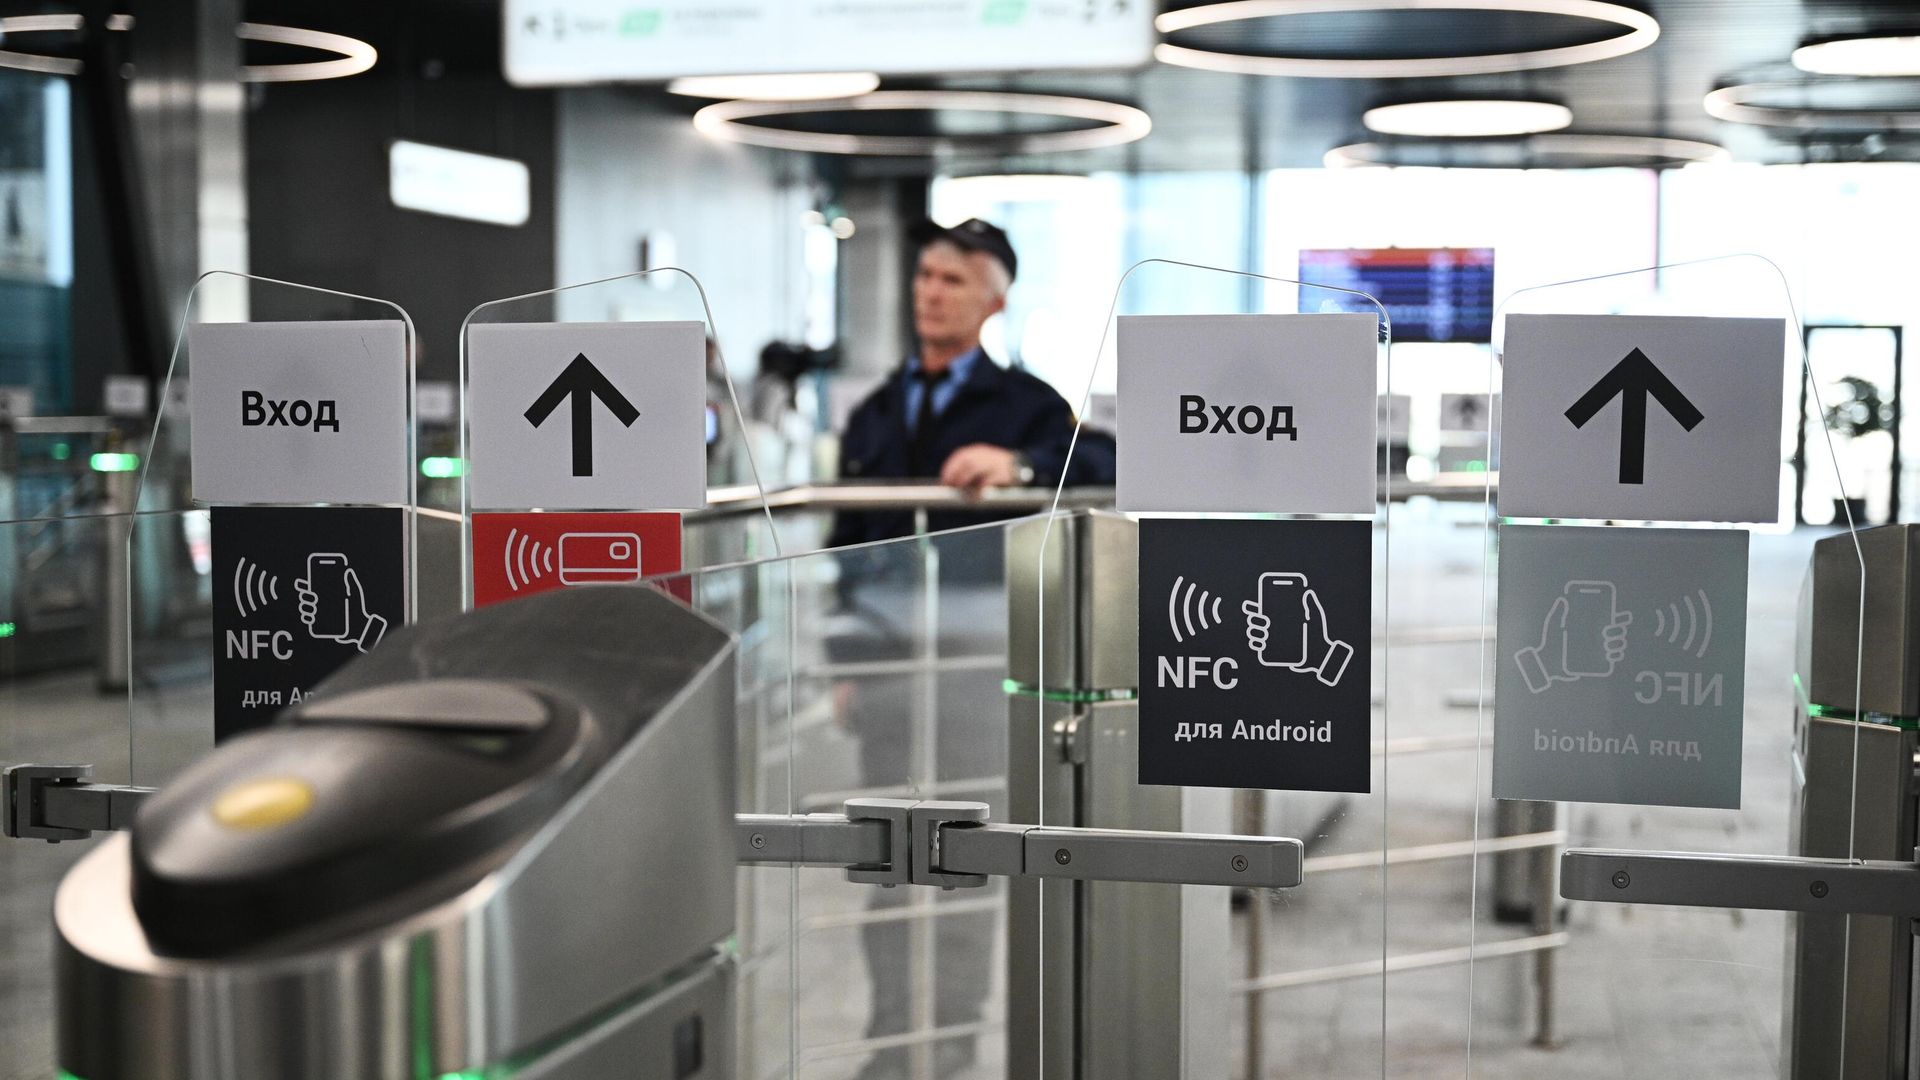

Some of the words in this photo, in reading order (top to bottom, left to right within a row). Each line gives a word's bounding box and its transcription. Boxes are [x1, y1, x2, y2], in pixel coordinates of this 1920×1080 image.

[242, 390, 339, 432] Вход
[1180, 395, 1297, 441] Вход
[227, 629, 294, 660] NFC
[1158, 656, 1239, 690] NFC
[241, 690, 282, 708] для
[1175, 722, 1222, 743] для
[1232, 719, 1332, 743] Android
